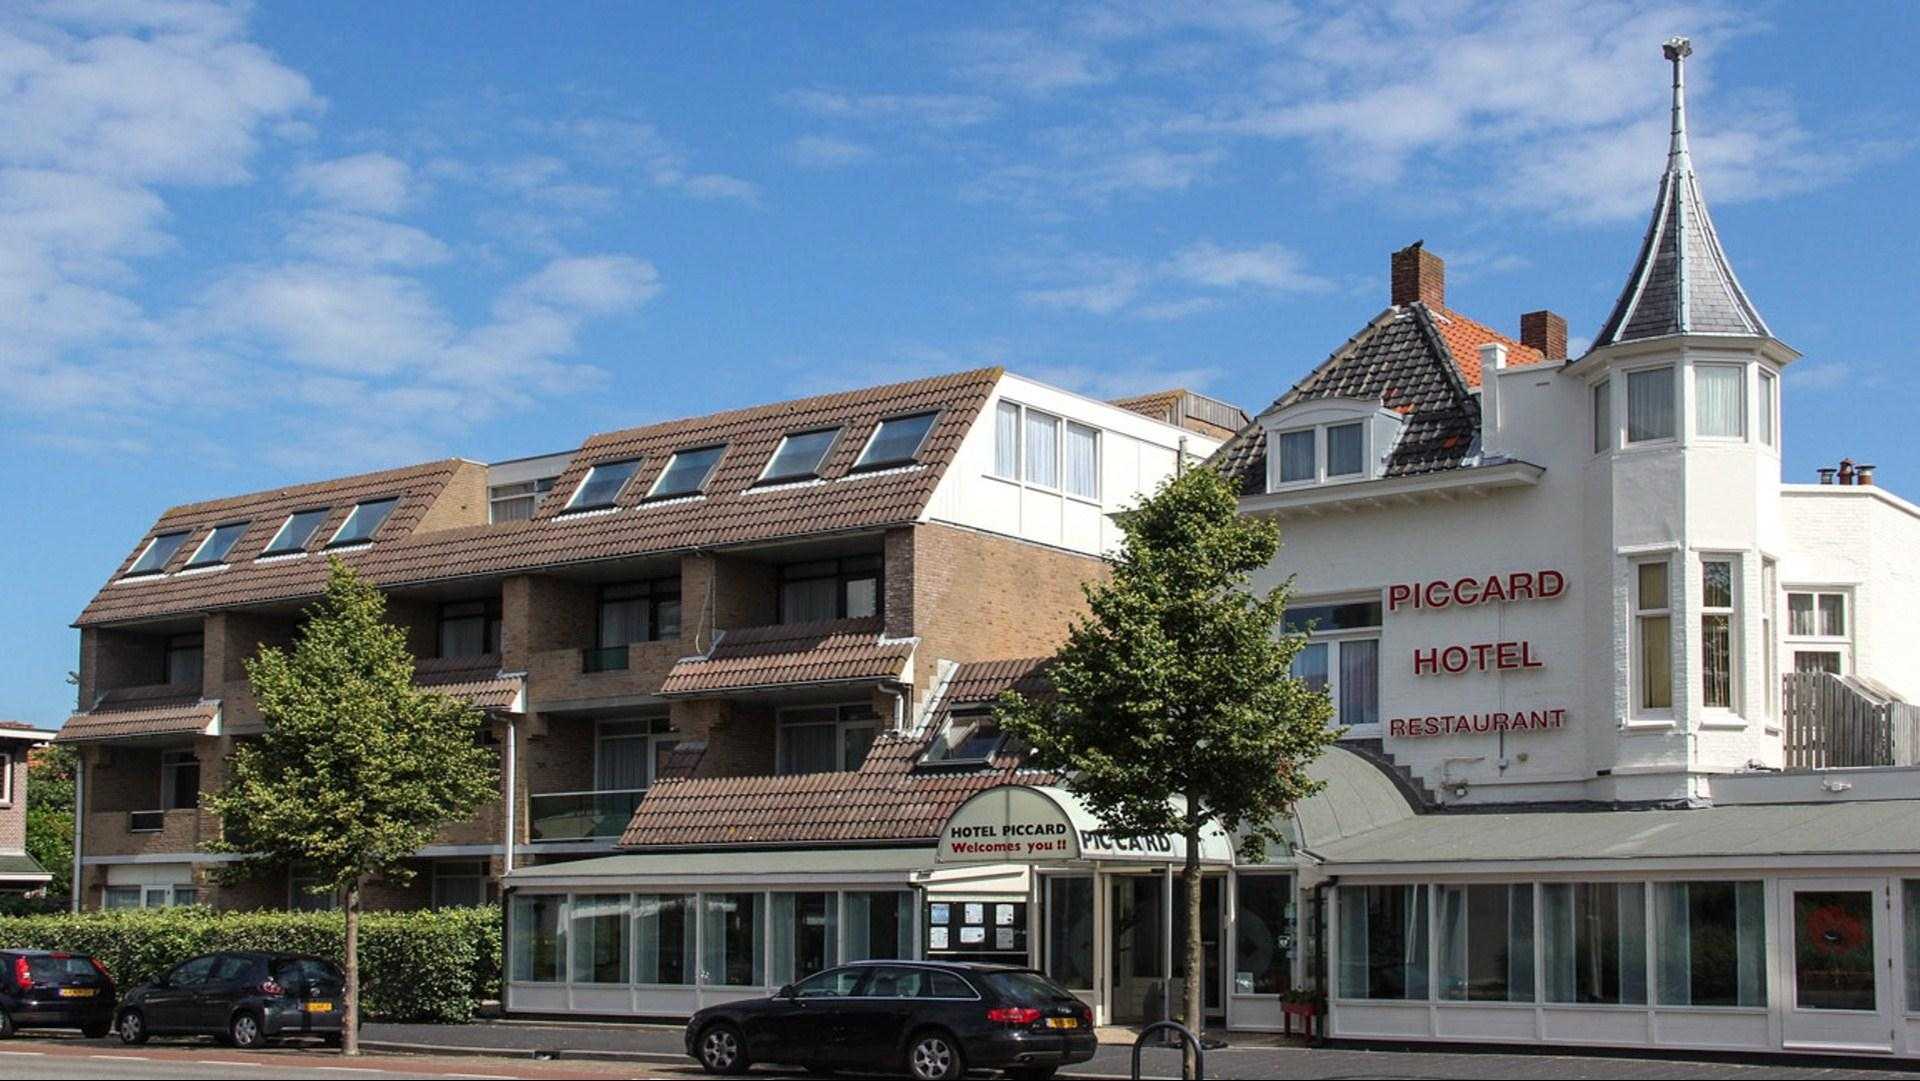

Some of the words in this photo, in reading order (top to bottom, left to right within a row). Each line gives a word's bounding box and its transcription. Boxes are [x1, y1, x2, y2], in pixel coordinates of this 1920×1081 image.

[1388, 569, 1565, 611] PICCARD
[1413, 640, 1543, 675] HOTEL
[1389, 708, 1566, 737] RESTAURANT
[951, 825, 997, 838] HOTEL
[1002, 823, 1067, 836] PICCARD
[951, 842, 1022, 854] Welcomes
[1027, 840, 1054, 854] you
